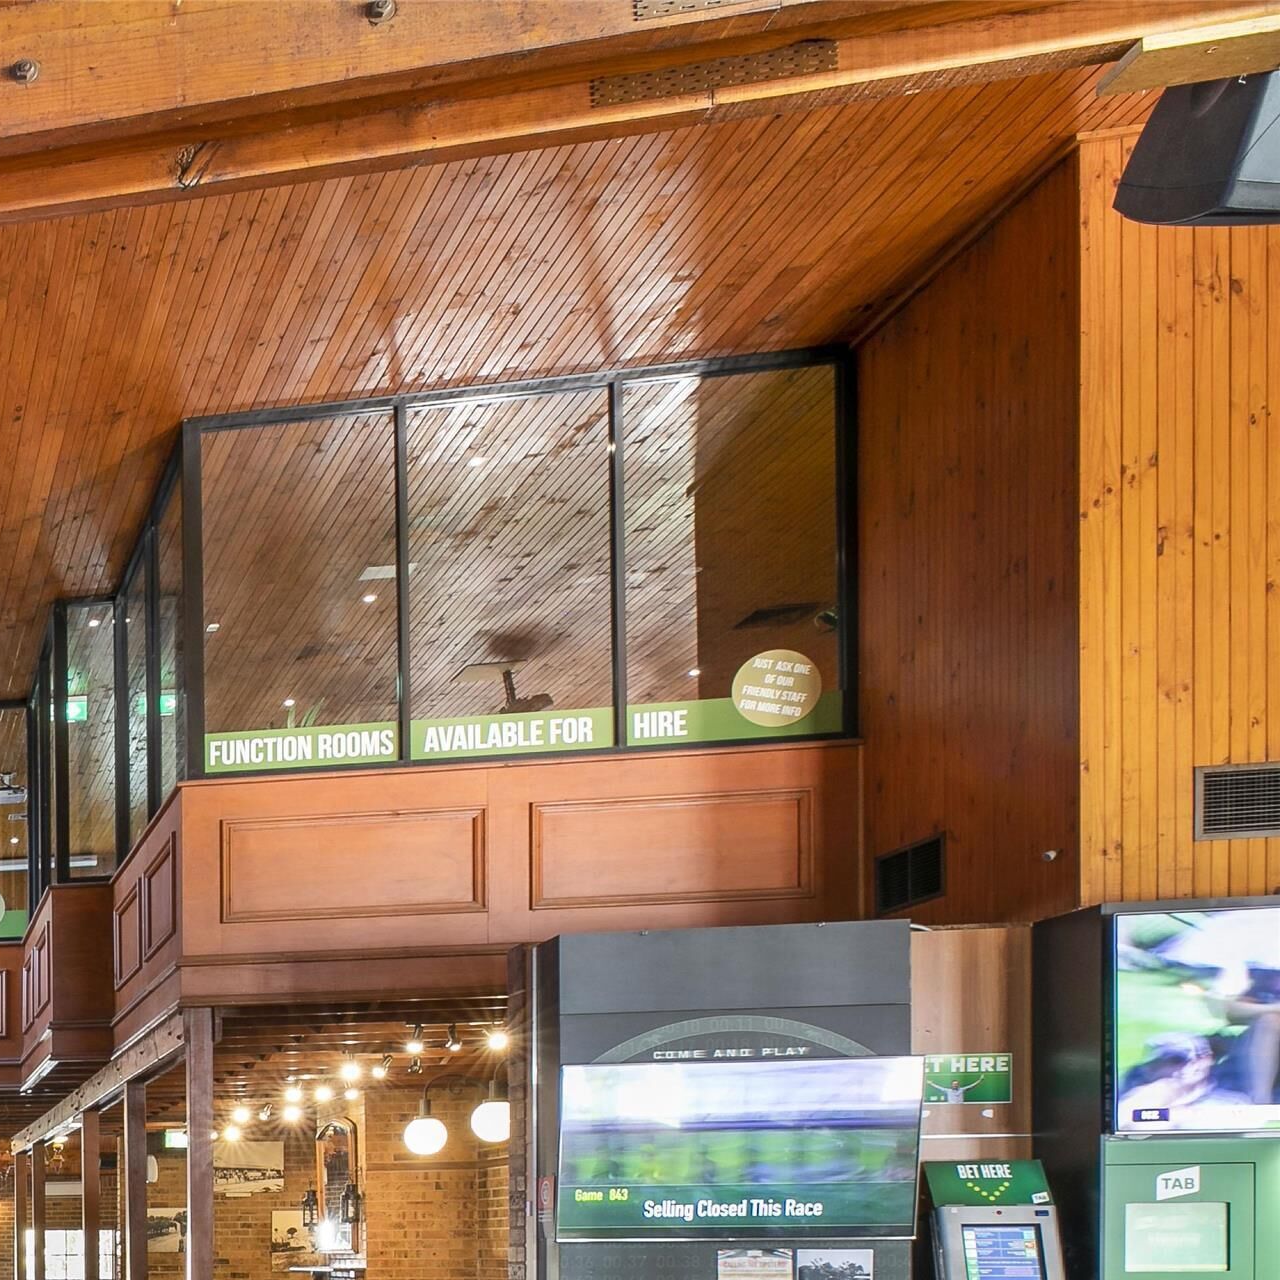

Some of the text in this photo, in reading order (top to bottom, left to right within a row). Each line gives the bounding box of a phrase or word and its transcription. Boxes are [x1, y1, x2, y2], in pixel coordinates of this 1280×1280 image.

[752, 658, 812, 675] JUST ASK ONE
[764, 673, 795, 687] OF OUR
[742, 684, 808, 703] FRIENDLY STAFF
[740, 698, 757, 711] FOR
[756, 701, 782, 715] MORE
[209, 709, 689, 767] FUNCTION ROOMS AVAILABLE FOR HIRE
[653, 1046, 808, 1060] COME AND PLAY
[950, 1056, 1009, 1073] HERE
[956, 1163, 1013, 1179] BET HERE
[1161, 1177, 1195, 1190] TAB
[575, 1188, 603, 1202] Game
[643, 1198, 824, 1222] Selling Closed This Race
